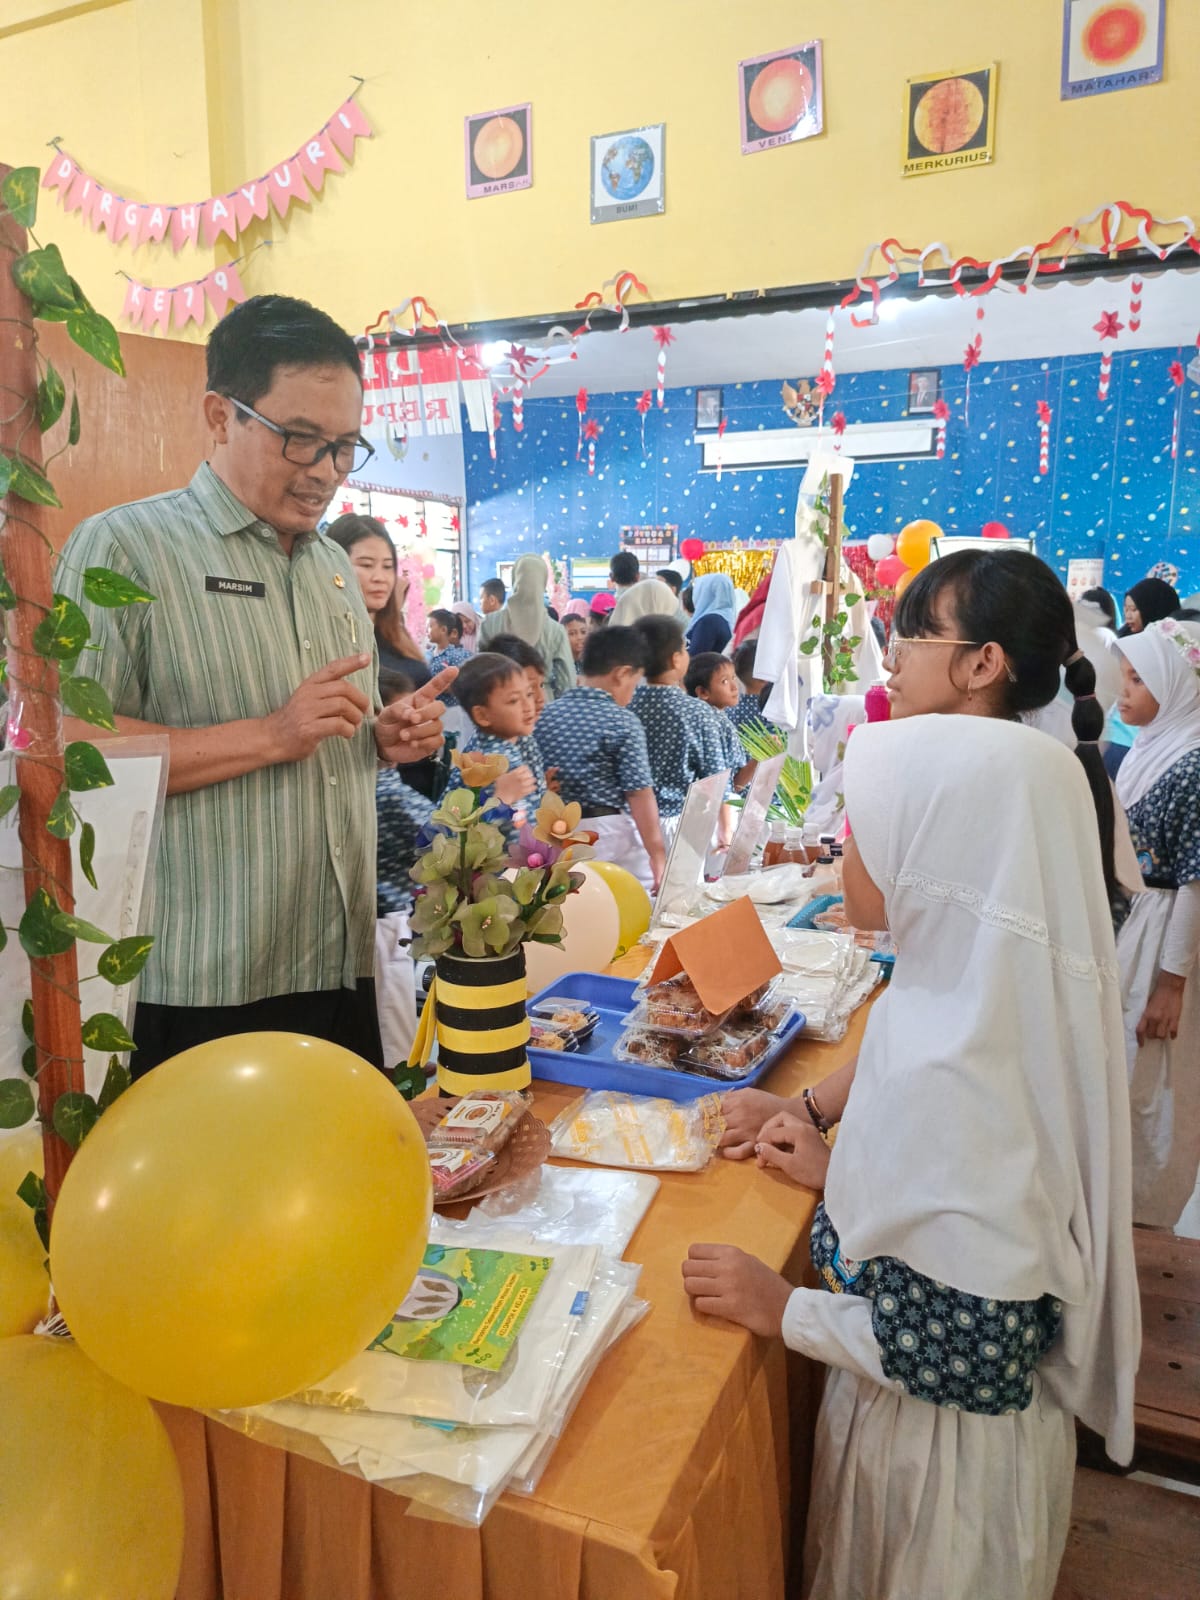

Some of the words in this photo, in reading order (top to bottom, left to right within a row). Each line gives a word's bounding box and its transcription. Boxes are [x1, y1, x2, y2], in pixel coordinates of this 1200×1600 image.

[1070, 71, 1154, 95] MATAHAR
[904, 151, 988, 173] MERKURIUS
[615, 203, 639, 214] BUMI
[219, 582, 252, 592] MARSIM
